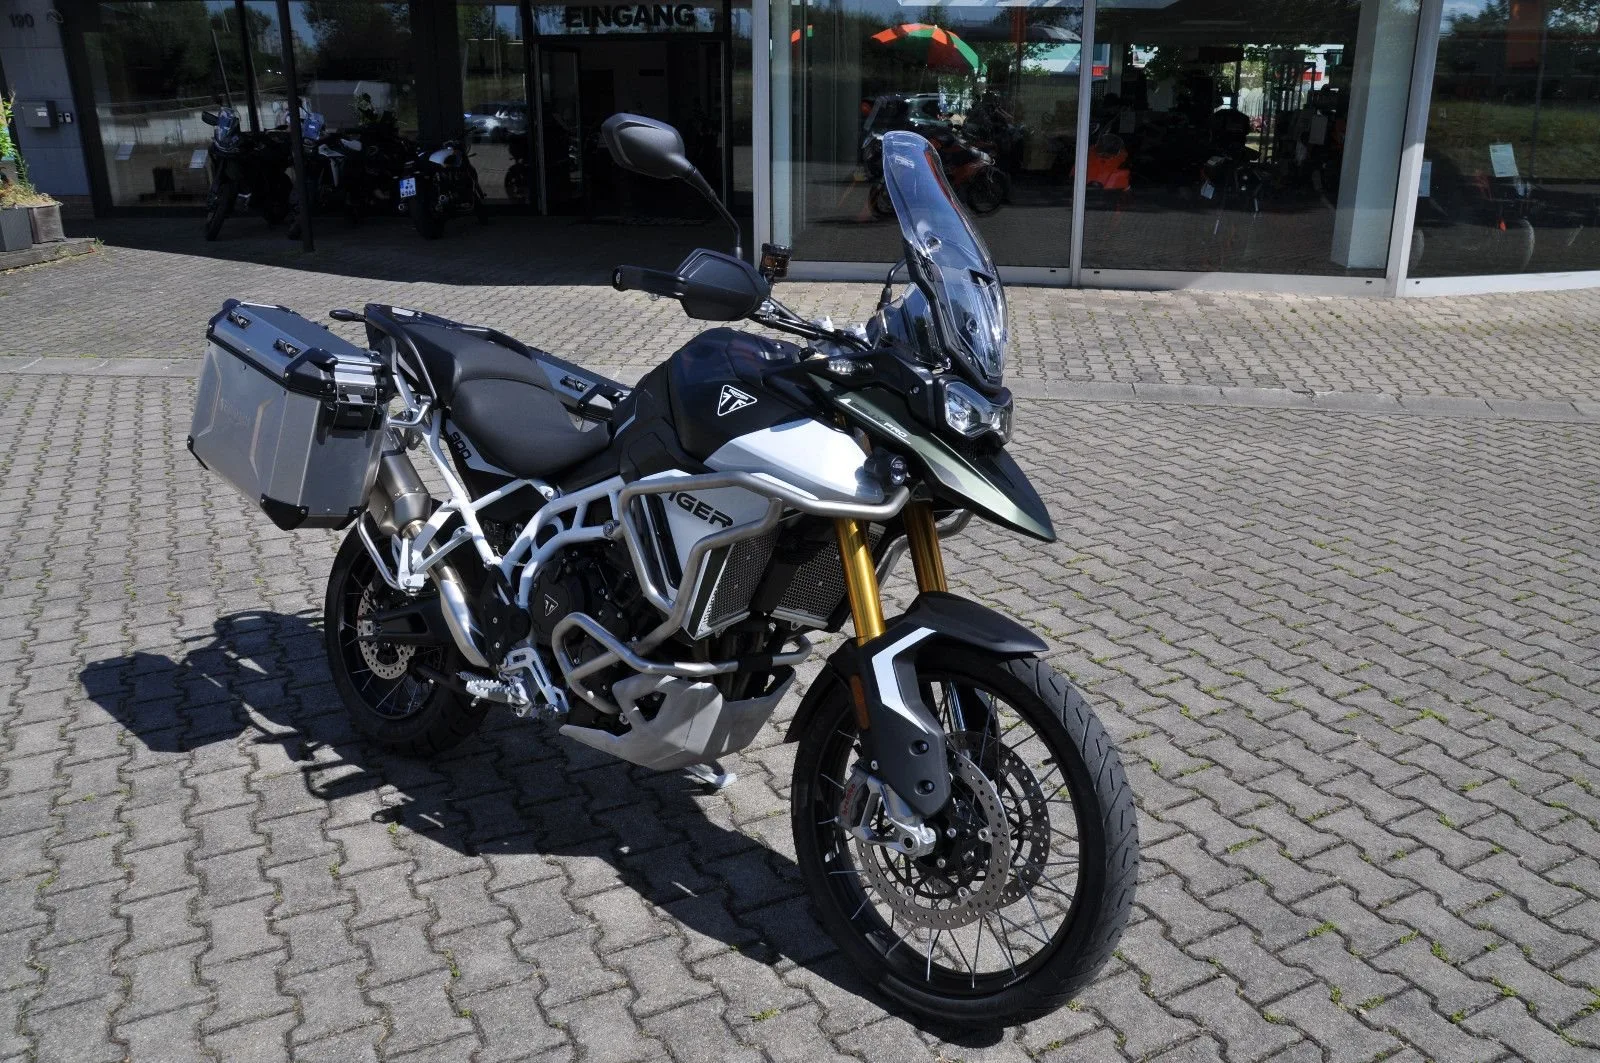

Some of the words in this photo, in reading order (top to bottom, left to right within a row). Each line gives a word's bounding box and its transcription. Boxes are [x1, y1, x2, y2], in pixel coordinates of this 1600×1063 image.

[565, 4, 696, 28] EINGANG
[884, 422, 908, 438] PRO
[668, 492, 734, 528] IGER
